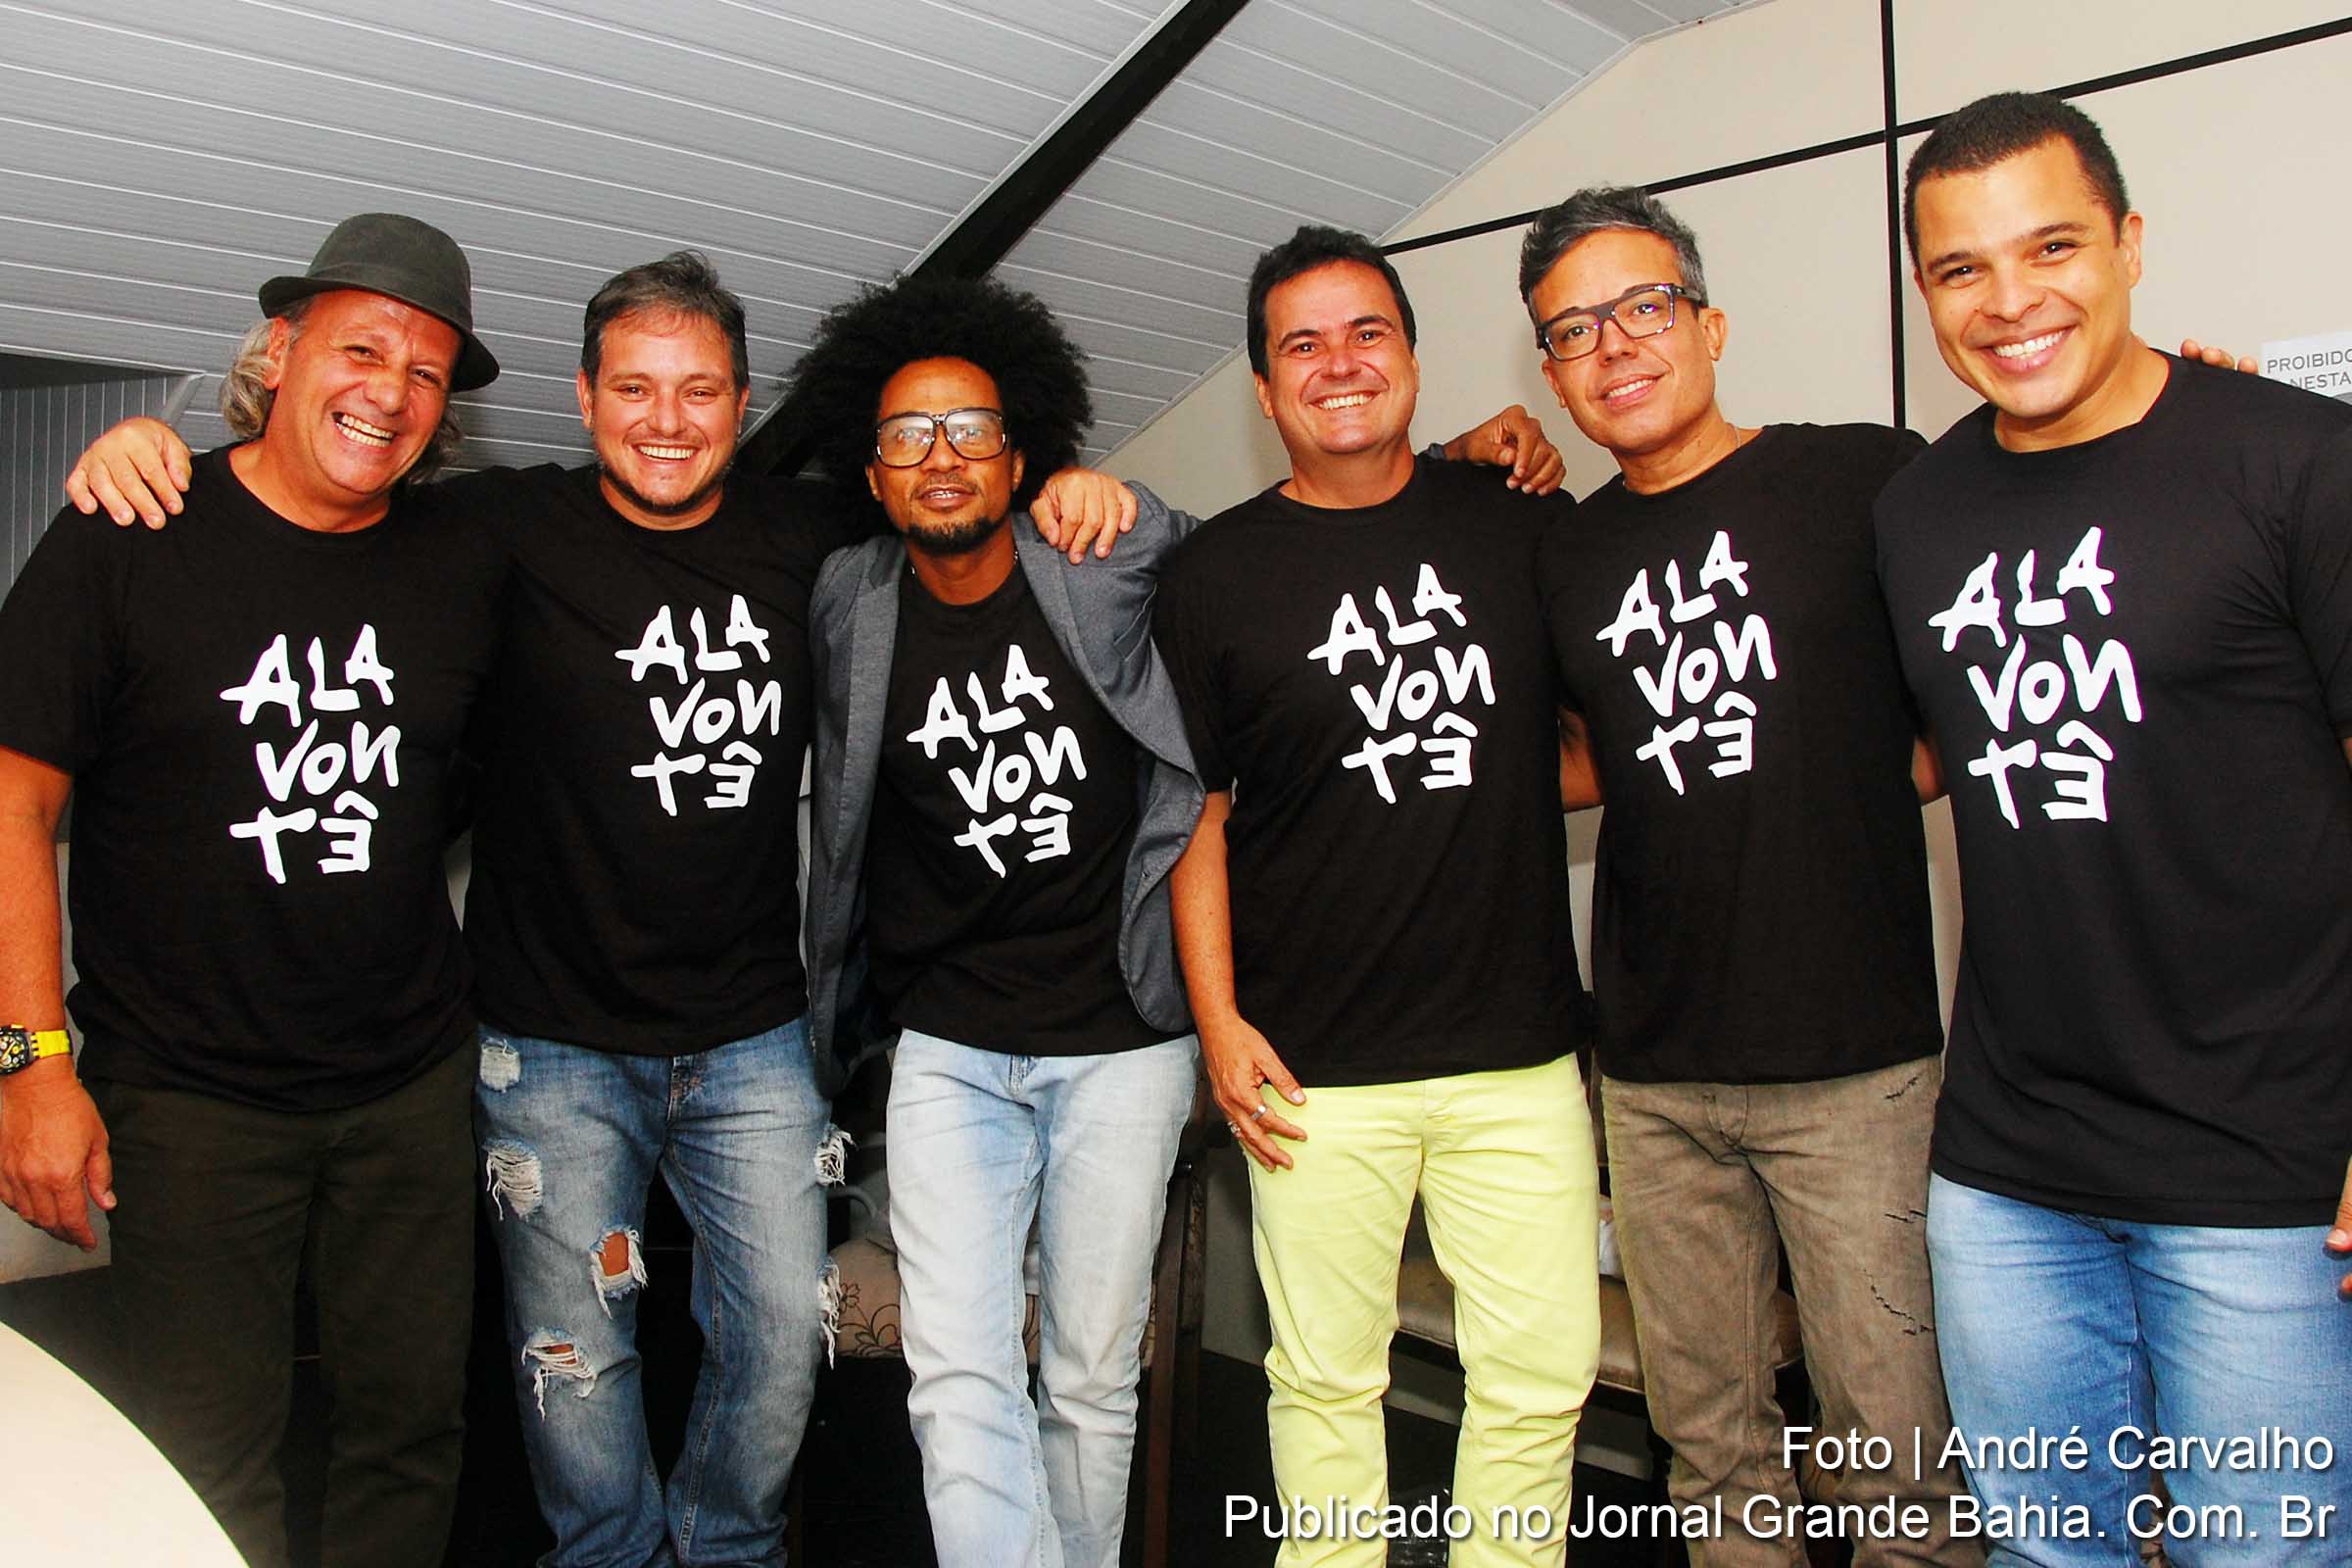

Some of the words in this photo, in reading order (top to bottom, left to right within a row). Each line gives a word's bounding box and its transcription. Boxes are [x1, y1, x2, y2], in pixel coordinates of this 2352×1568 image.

[2289, 371, 2352, 390] NESTA
[614, 594, 771, 685] ALA
[1306, 563, 1467, 676] ALA
[1595, 530, 1749, 658] ALA
[1928, 526, 2115, 653] ALA
[220, 623, 395, 728] ALA
[906, 644, 1054, 760] ALA
